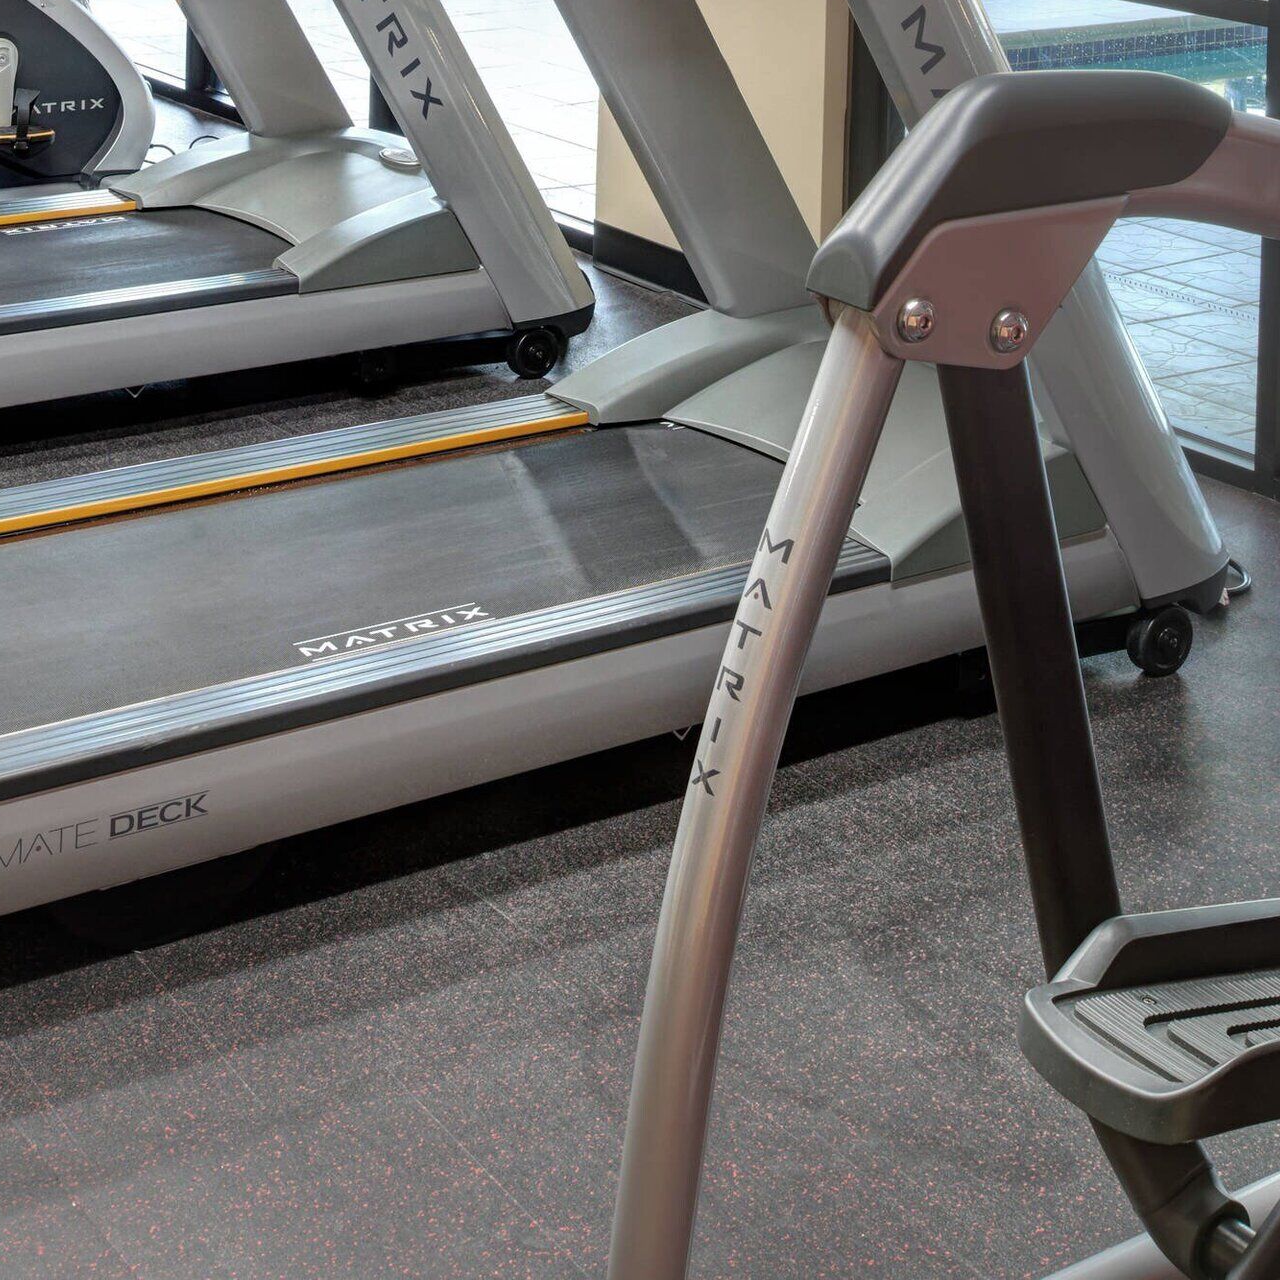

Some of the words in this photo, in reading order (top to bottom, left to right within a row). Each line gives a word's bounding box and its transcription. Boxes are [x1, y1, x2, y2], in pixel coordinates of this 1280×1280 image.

[298, 606, 489, 657] MATRIX
[692, 528, 794, 797] MATRIX
[110, 794, 208, 838] DECK
